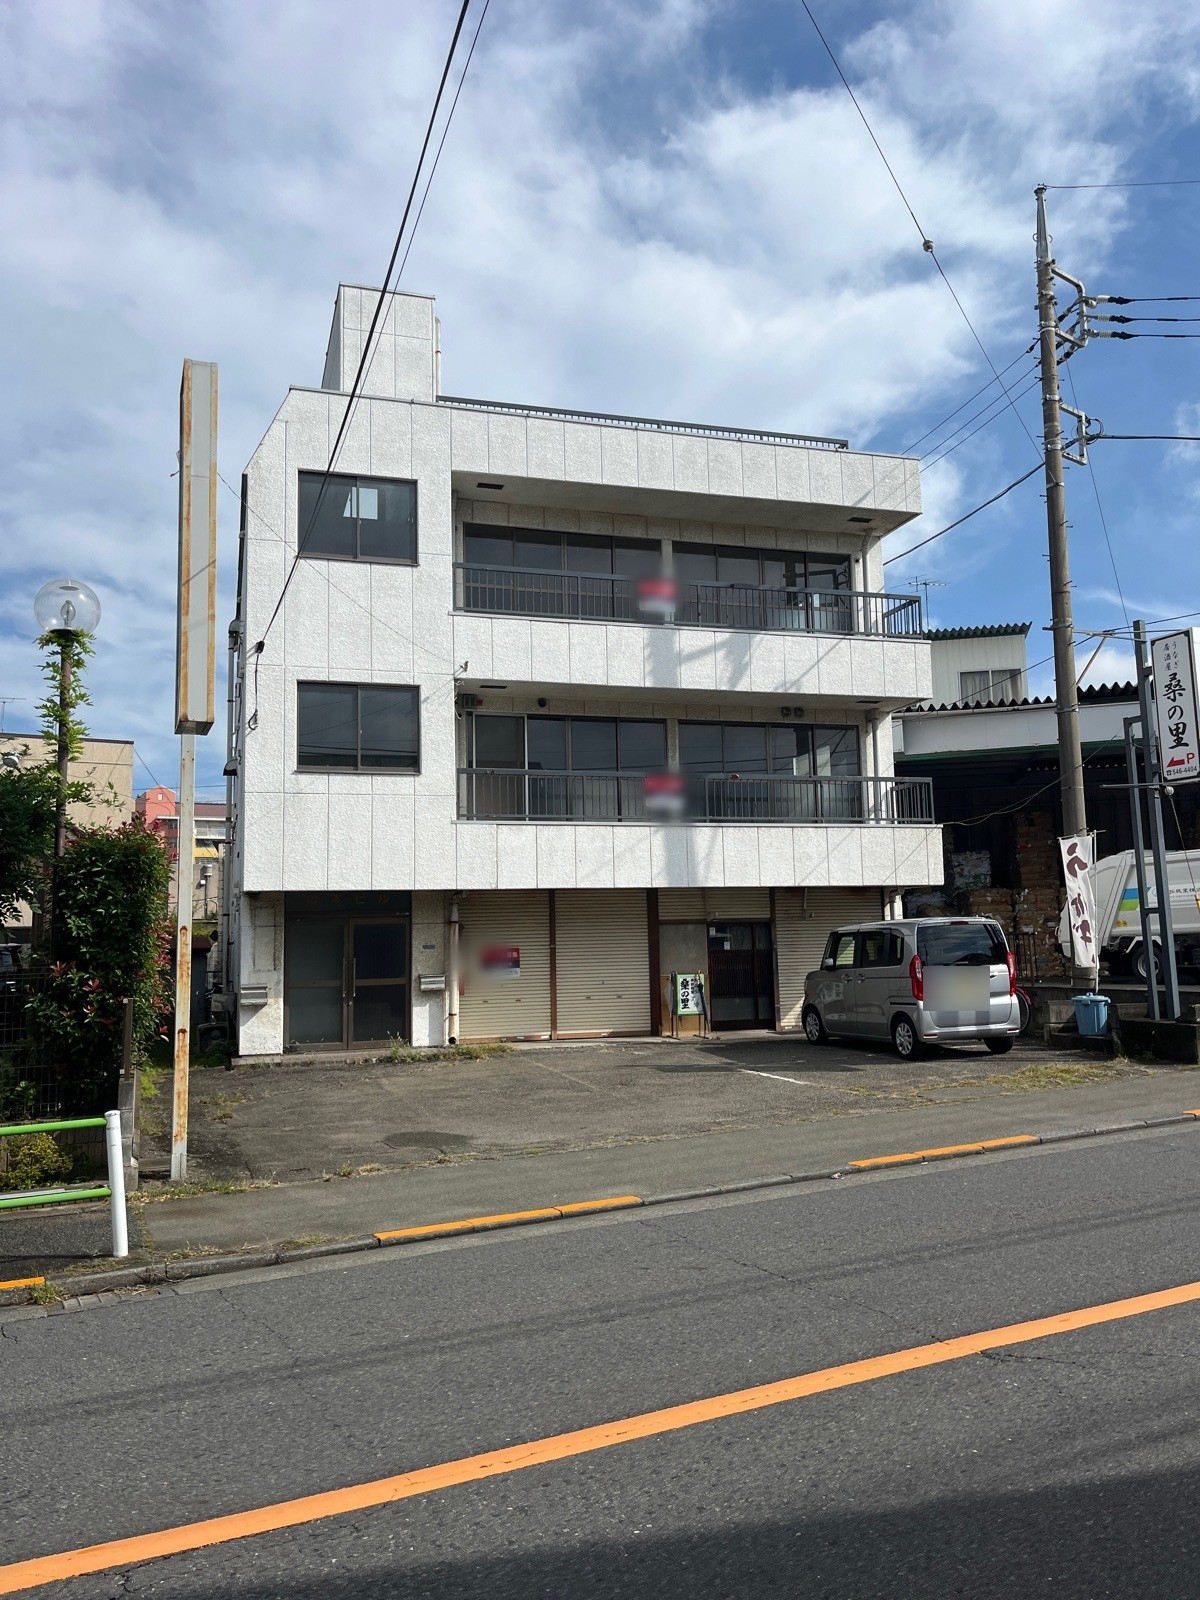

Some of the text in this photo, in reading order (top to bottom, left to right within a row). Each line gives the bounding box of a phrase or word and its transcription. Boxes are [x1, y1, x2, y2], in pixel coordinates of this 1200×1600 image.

[1163, 643, 1172, 672] 居酒屋
[1163, 672, 1190, 750] 桑の里
[1186, 752, 1195, 764] P
[680, 978, 690, 1009] 桑の里
